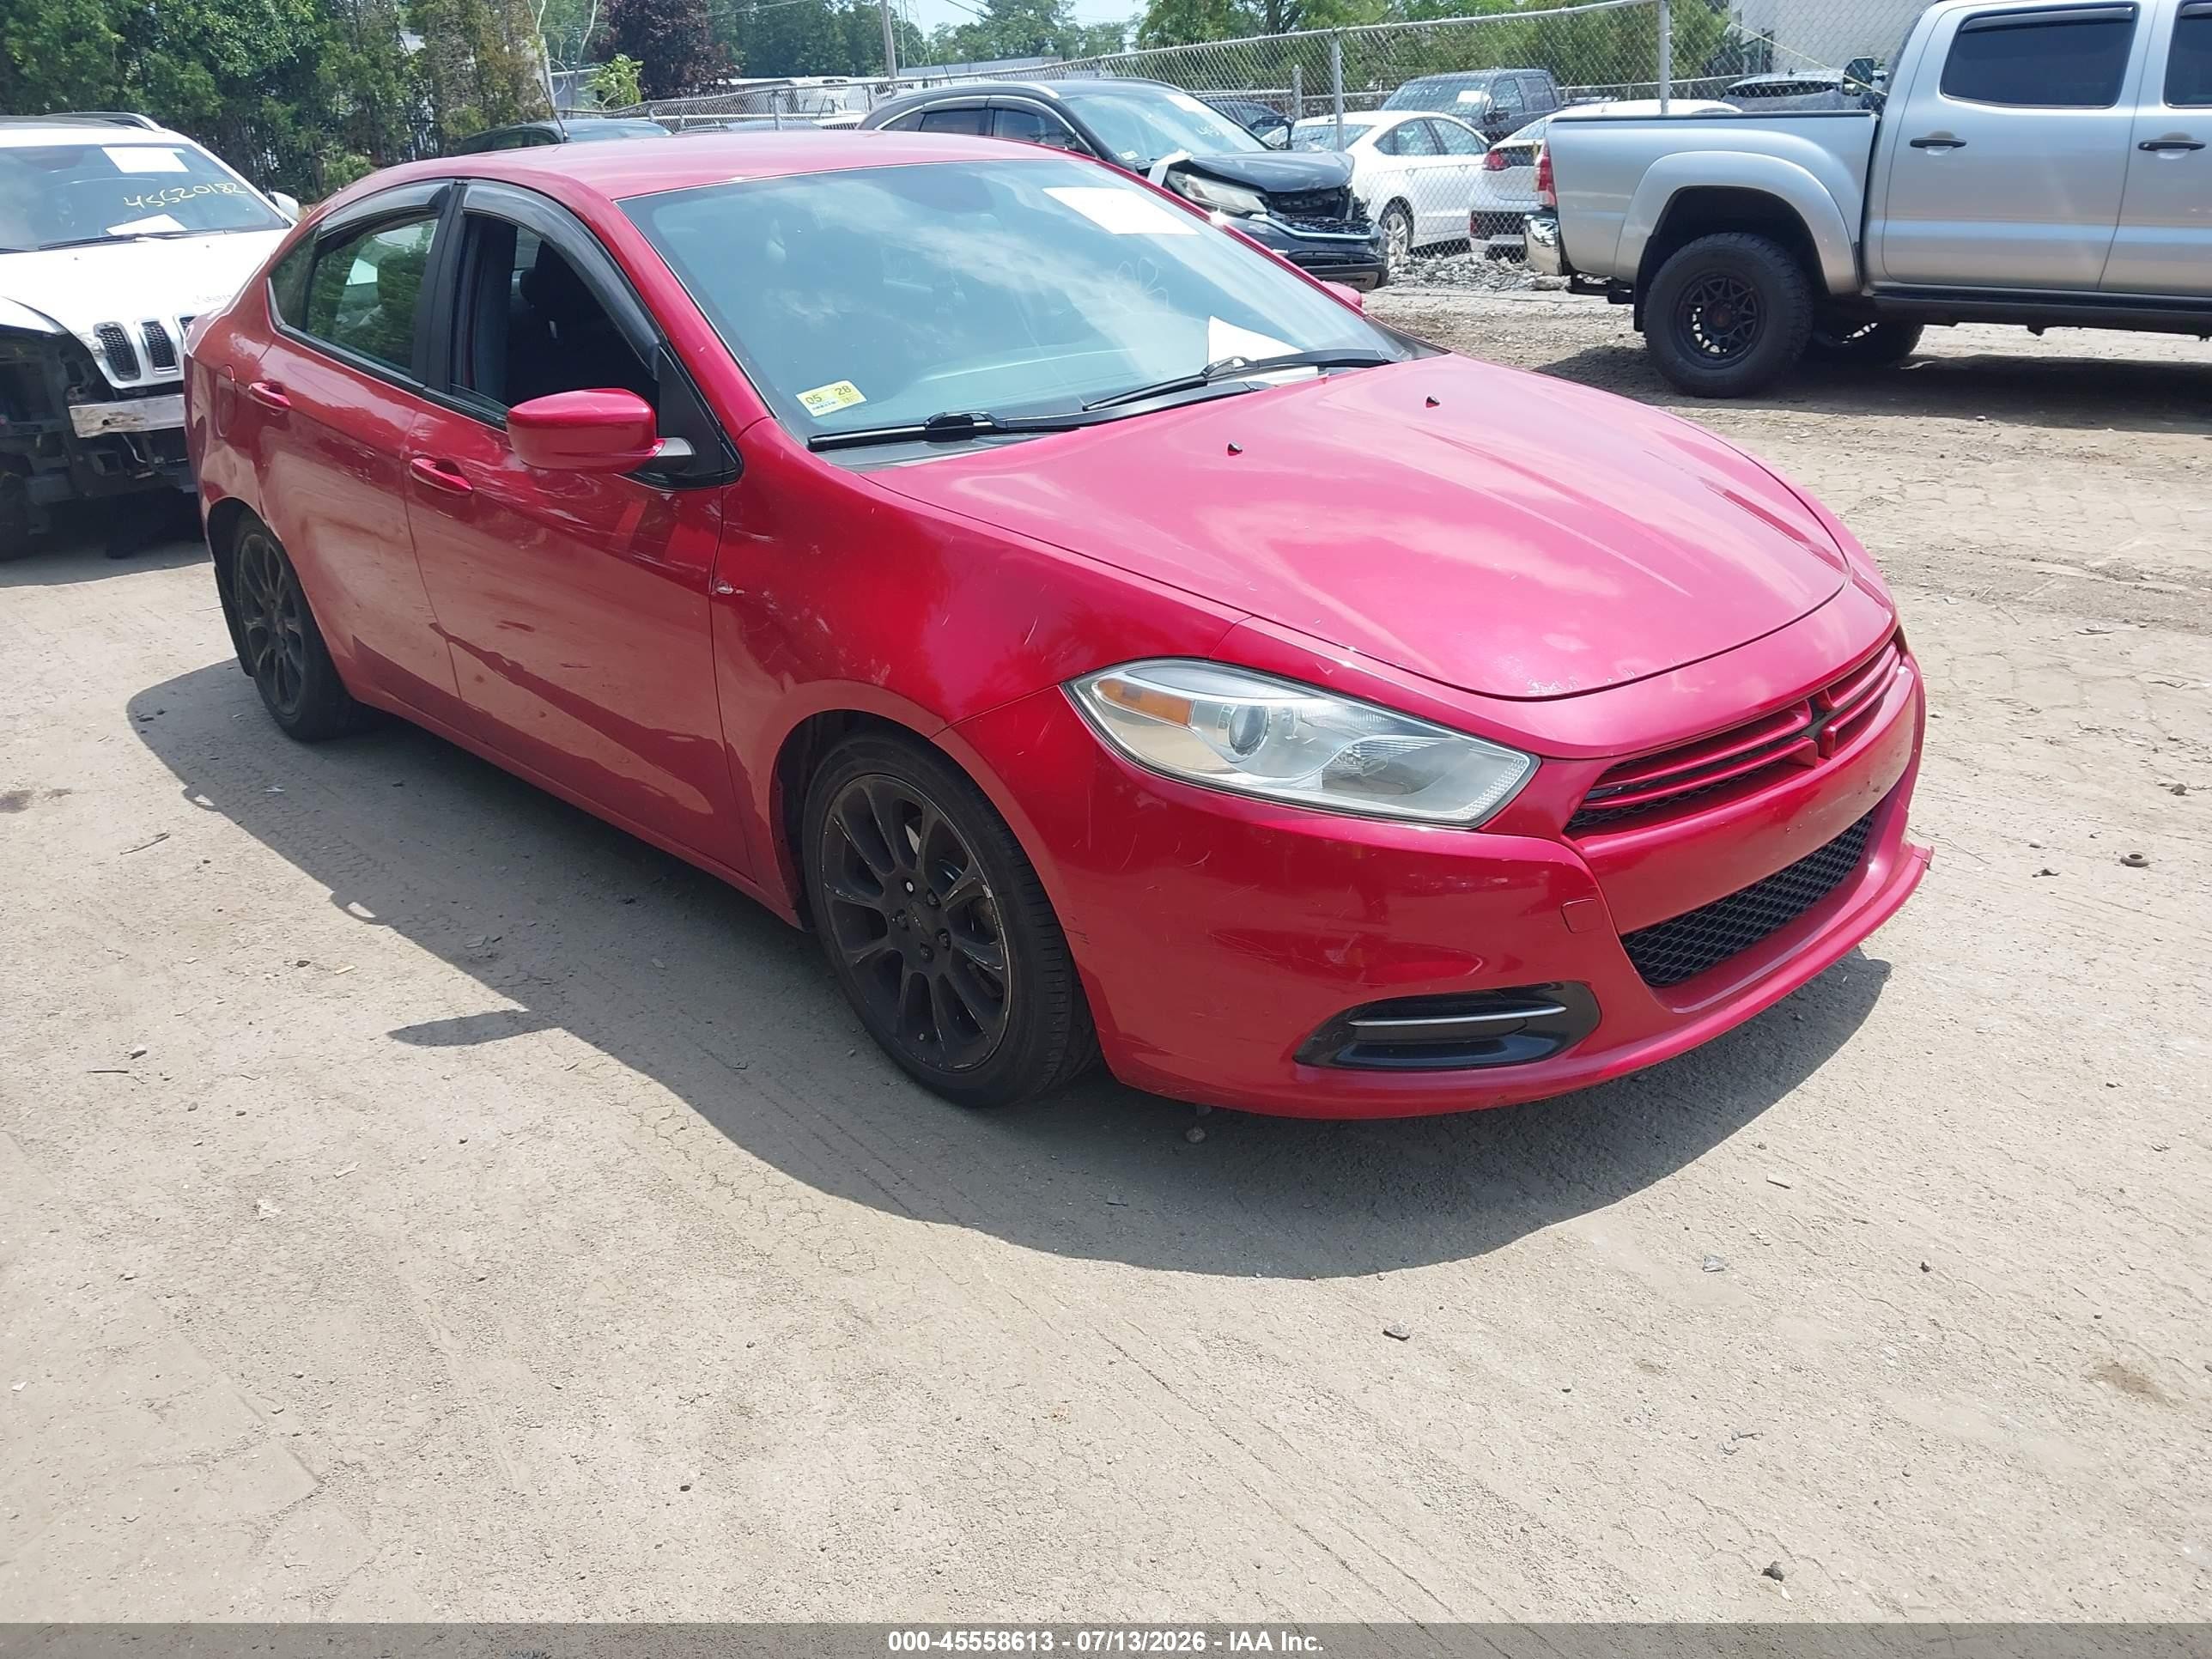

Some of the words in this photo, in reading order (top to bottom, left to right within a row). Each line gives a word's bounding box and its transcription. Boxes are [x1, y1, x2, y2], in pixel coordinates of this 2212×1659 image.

[123, 183, 246, 208] 45520182
[805, 394, 822, 404] 05
[835, 386, 851, 396] 28
